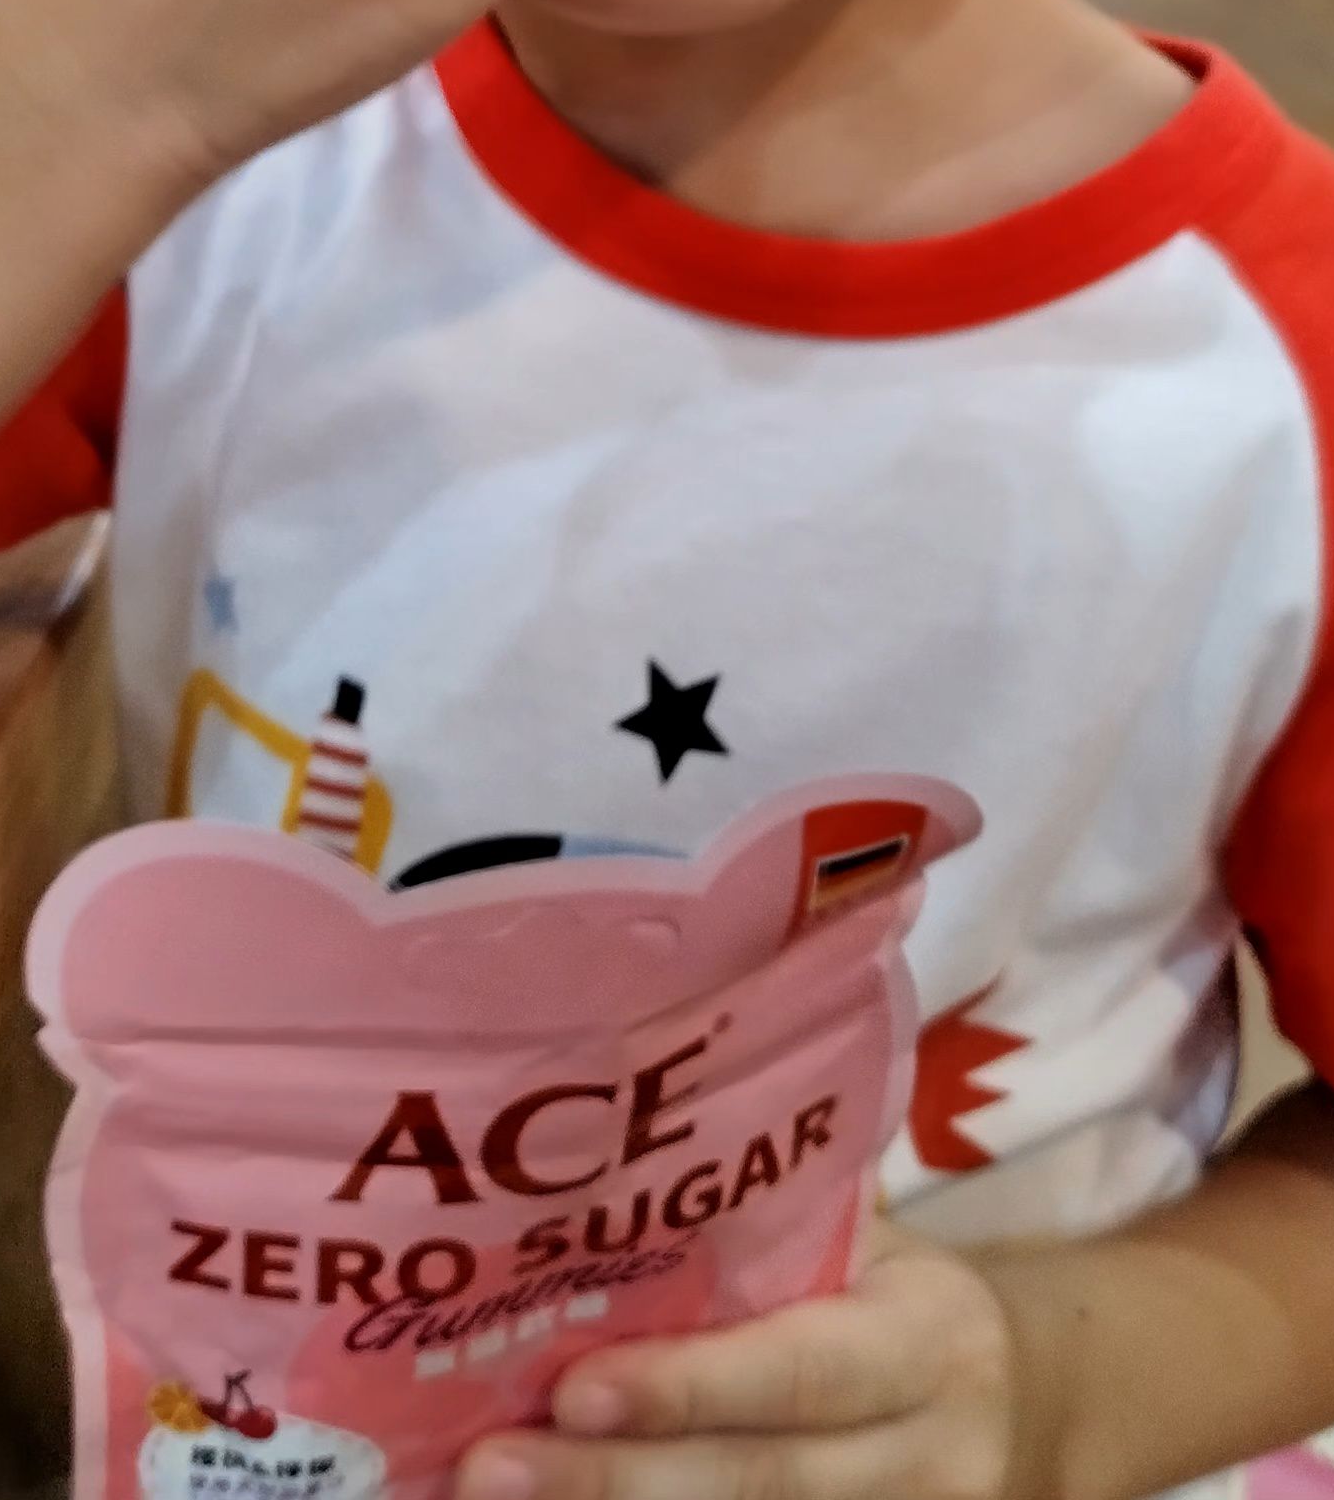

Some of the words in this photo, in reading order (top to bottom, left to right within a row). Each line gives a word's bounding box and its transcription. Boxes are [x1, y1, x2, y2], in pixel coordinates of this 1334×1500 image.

[167, 1218, 479, 1305] ZERO
[513, 1094, 840, 1276] SUGAR
[326, 1037, 711, 1205] ACE
